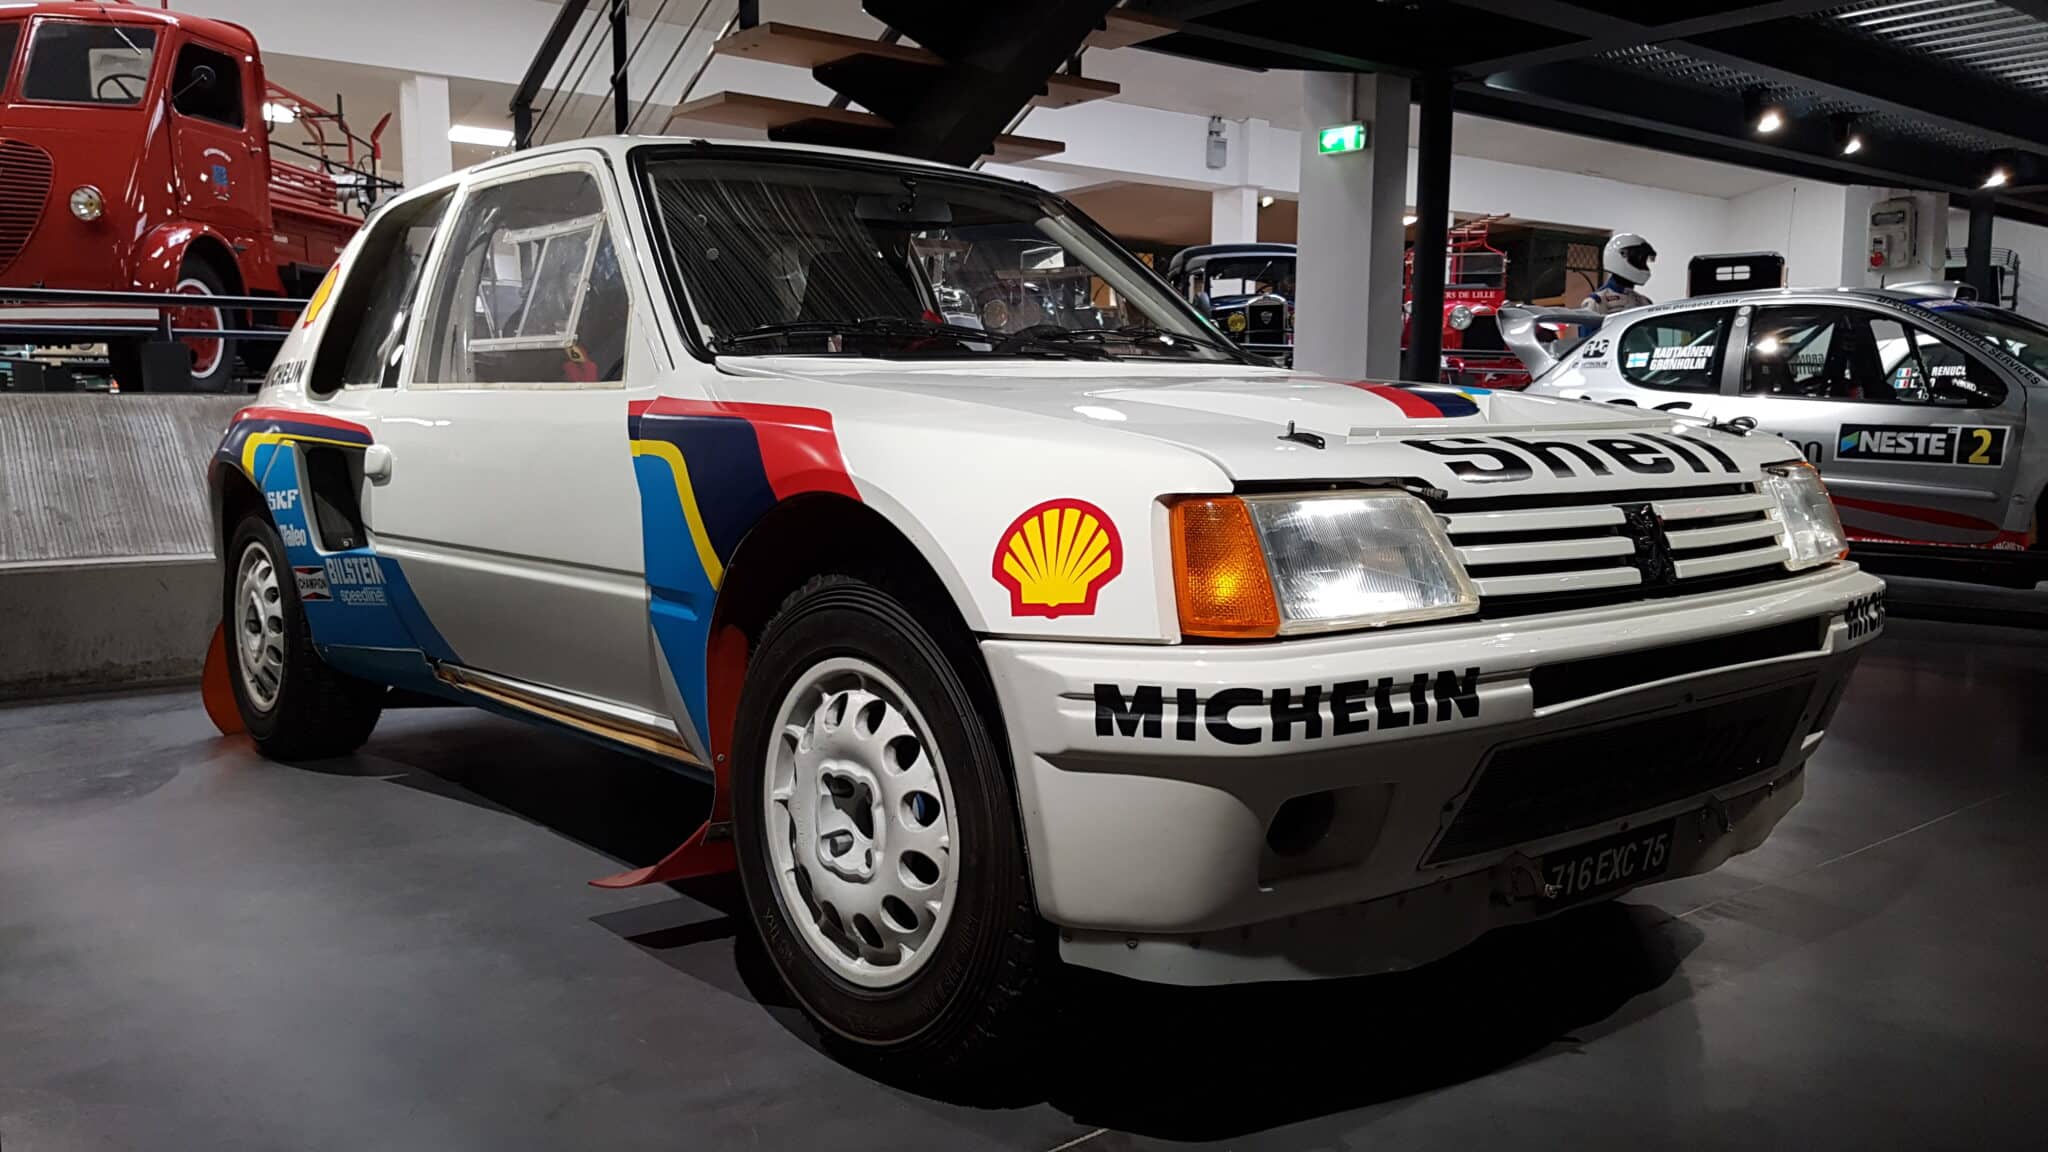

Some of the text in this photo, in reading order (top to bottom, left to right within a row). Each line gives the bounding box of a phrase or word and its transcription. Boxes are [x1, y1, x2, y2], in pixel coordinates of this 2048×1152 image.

[1458, 291, 1470, 299] DE
[1472, 291, 1496, 299] LILLE
[1988, 348, 2041, 385] SERVICES
[1401, 432, 1741, 484] Shell
[1858, 431, 1947, 456] NESTE
[1968, 428, 1993, 464] 2
[267, 488, 299, 511] SKF
[298, 577, 328, 590] CHAMPION
[325, 557, 387, 585] BILSTEIN
[1093, 666, 1481, 745] MICHELIN
[1641, 833, 1667, 871] 75
